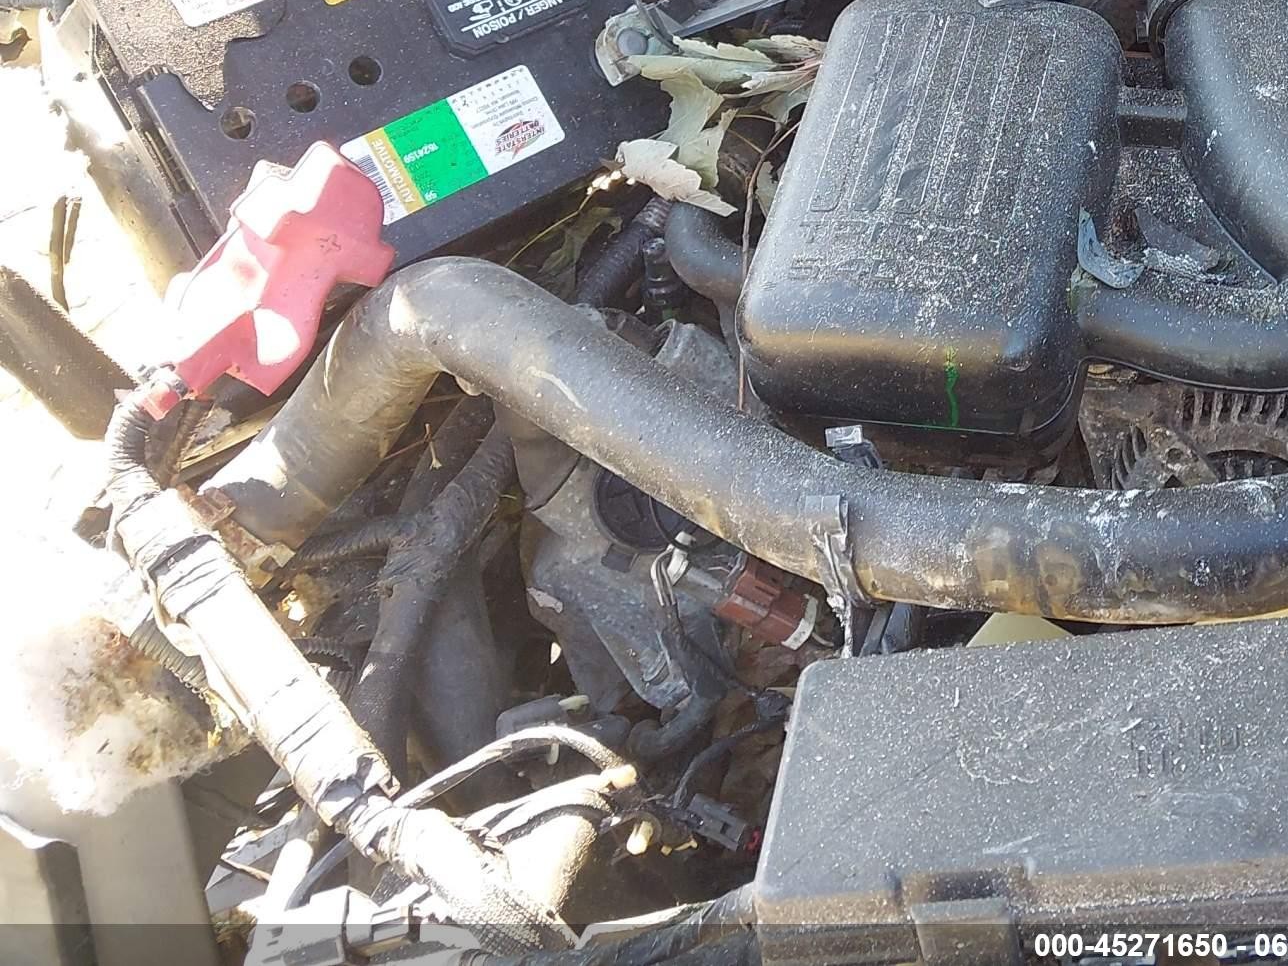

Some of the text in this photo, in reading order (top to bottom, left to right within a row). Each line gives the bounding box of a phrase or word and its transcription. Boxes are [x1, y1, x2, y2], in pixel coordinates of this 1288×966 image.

[471, 12, 516, 39] POISON
[494, 119, 539, 144] BATTERIES
[494, 126, 545, 154] INTERSTATE
[370, 138, 415, 203] AUTOMOTIVE
[423, 189, 437, 201] 59
